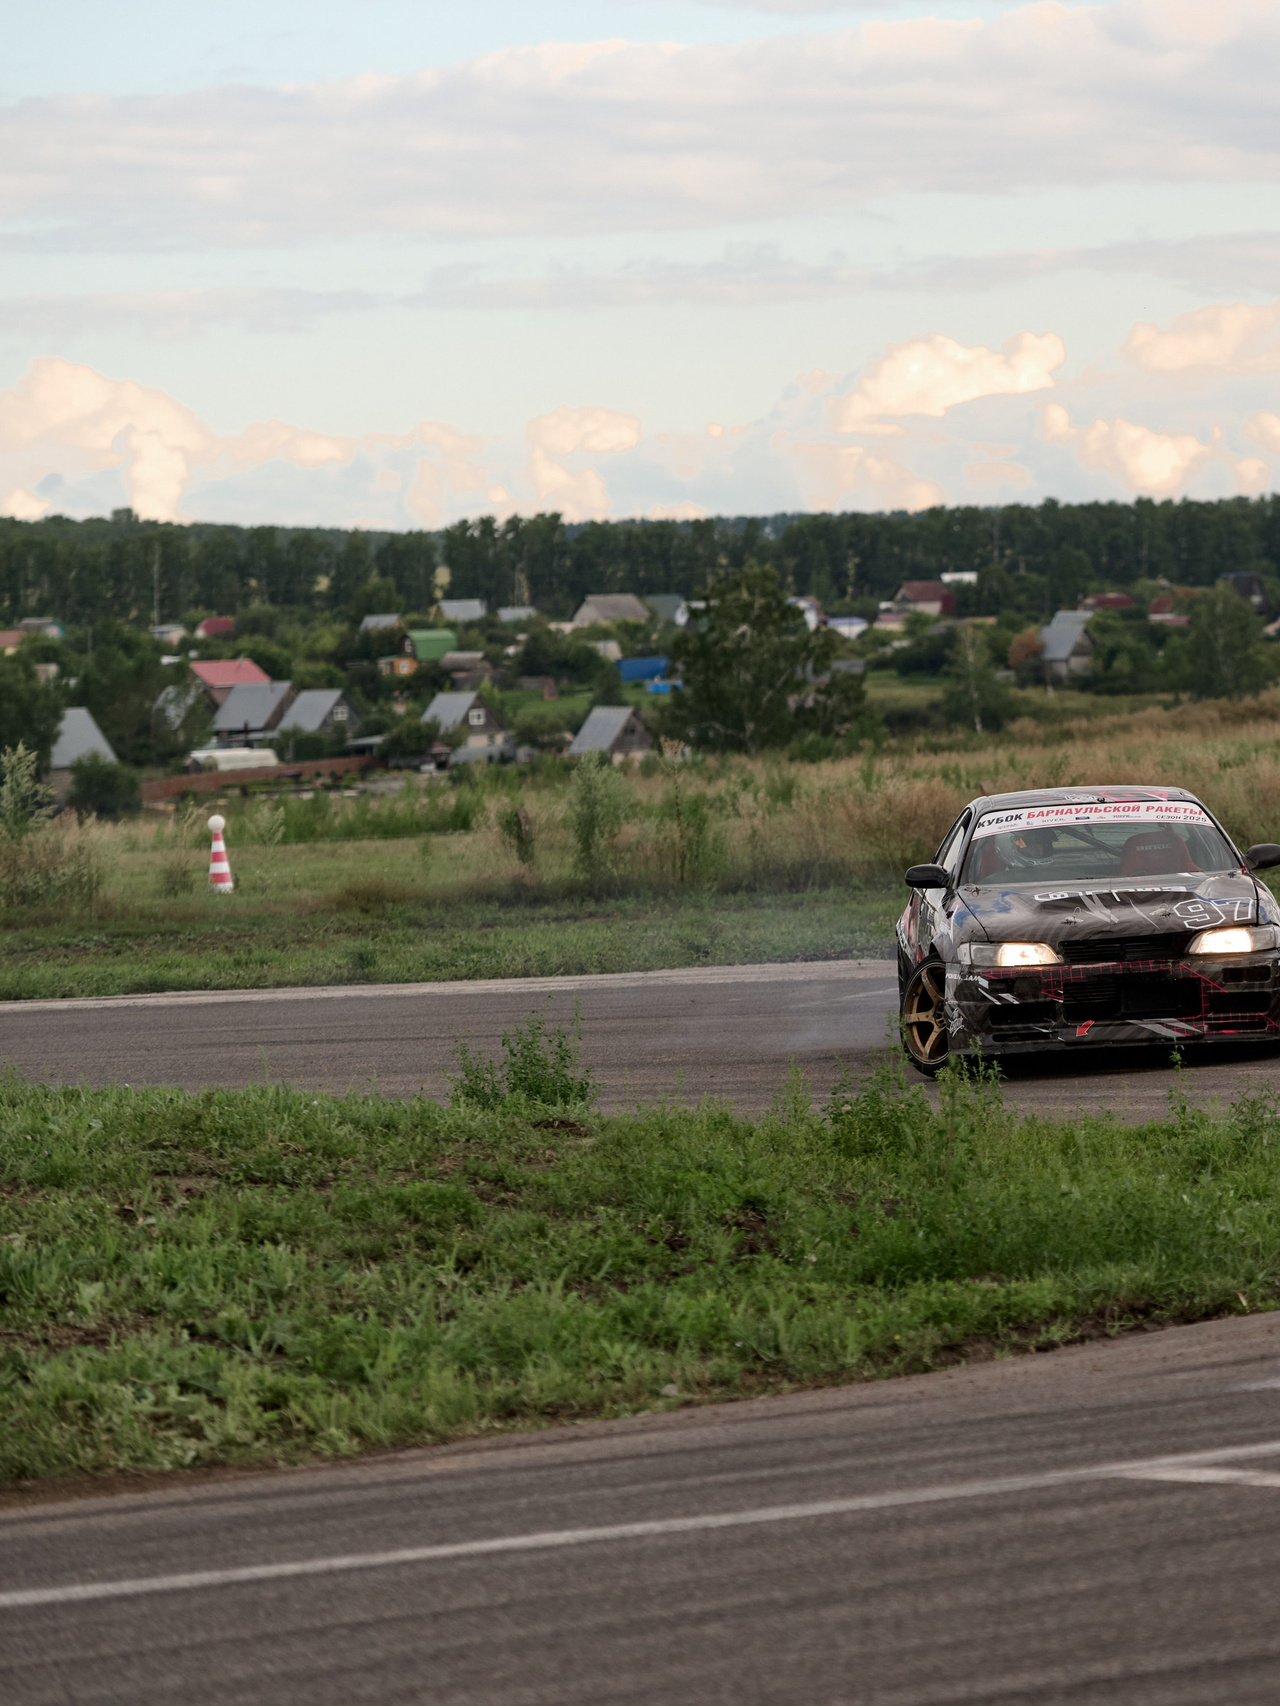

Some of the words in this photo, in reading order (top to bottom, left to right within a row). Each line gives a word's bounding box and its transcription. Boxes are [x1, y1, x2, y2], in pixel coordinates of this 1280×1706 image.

[977, 812, 1023, 829] КУБОК
[1027, 804, 1141, 819] БАРНАУЛЬСКОЙ
[1145, 805, 1203, 816] РАКЕТЫ
[1183, 814, 1207, 823] 2025
[1173, 897, 1253, 929] 97
